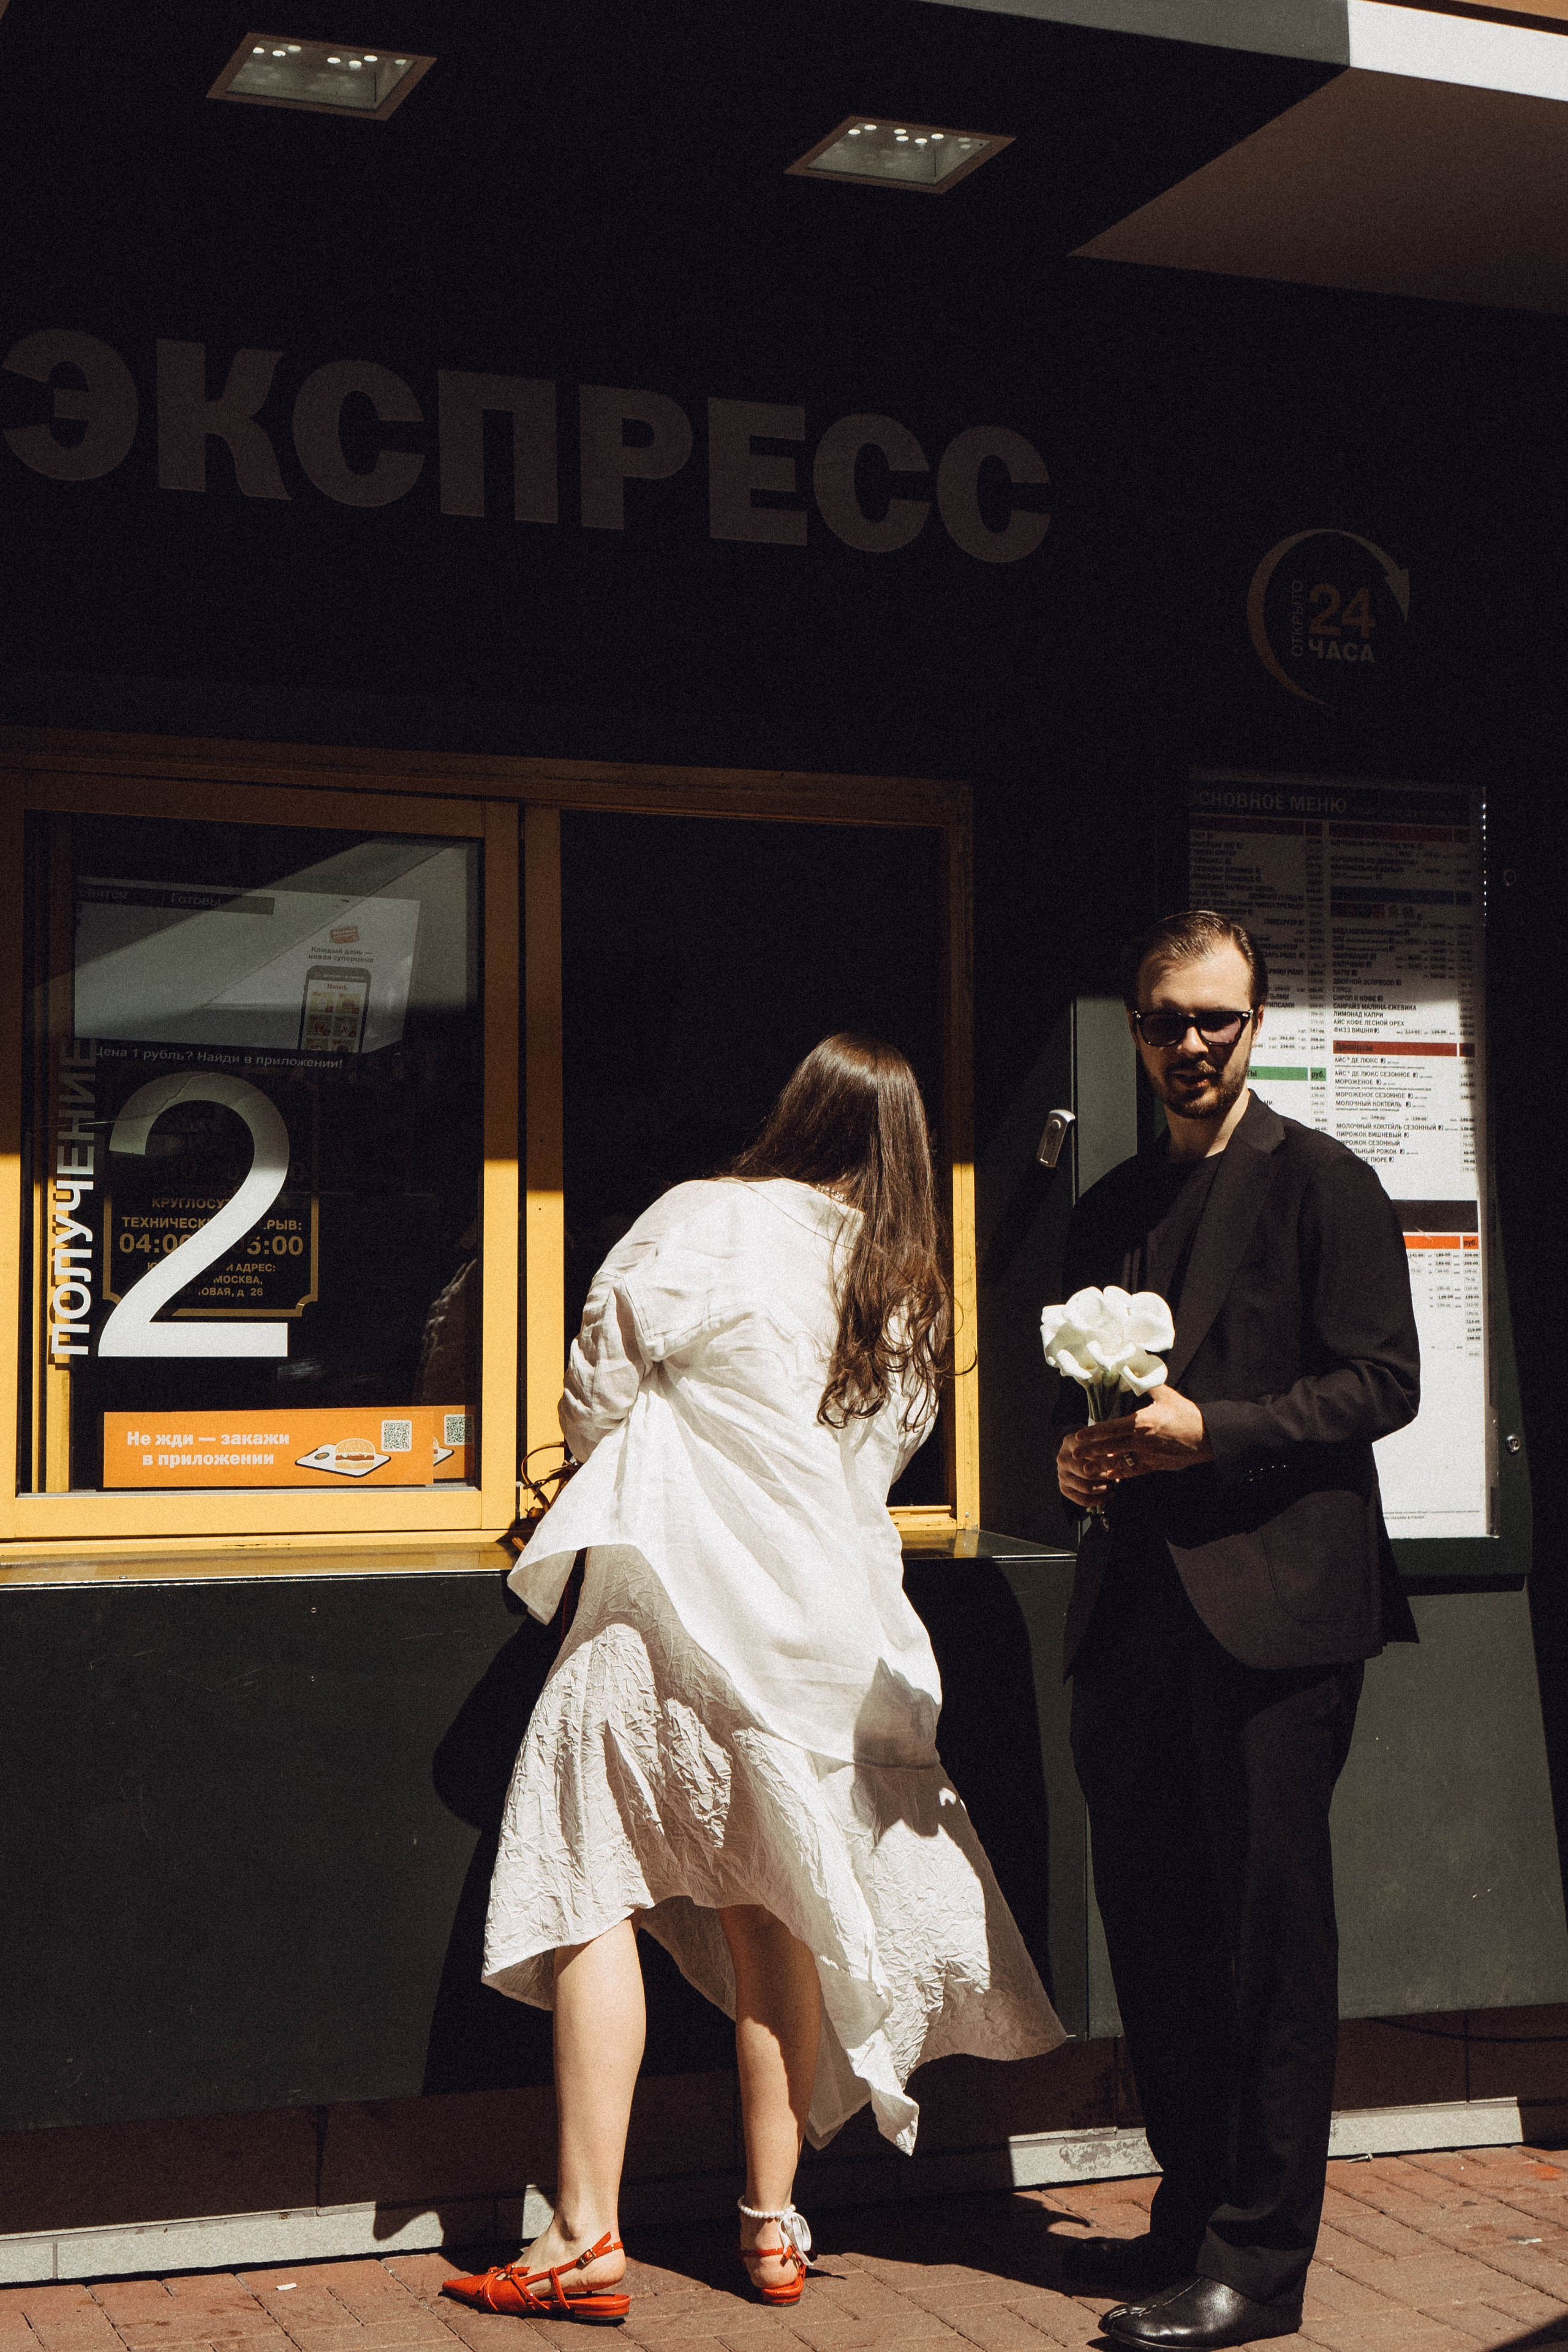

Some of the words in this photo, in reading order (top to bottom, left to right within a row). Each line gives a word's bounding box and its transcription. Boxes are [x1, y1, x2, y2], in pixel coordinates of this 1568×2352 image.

[2, 328, 1052, 563] ЭКСПРЕСС
[1309, 583, 1376, 638] 24
[1308, 639, 1375, 662] ЧАСА
[1289, 795, 1345, 813] МЕНЮ
[131, 1048, 138, 1058] 1
[142, 1049, 192, 1063] рубль?
[197, 1051, 240, 1063] Найди
[256, 1056, 344, 1069] приложении!
[1311, 1071, 1325, 1079] руб.
[51, 1037, 97, 1355] ПОЛУЧЕНИЕ
[98, 1071, 290, 1357] 2
[121, 1217, 211, 1229] ТЕХНИЧЕСК
[263, 1220, 302, 1231] РЫВ:
[1463, 1238, 1478, 1247] руб.
[236, 1262, 276, 1274] АДРЕС:
[201, 1287, 235, 1298] ОВАЯ,
[250, 1287, 263, 1297] 26
[127, 1431, 151, 1445] Не
[155, 1433, 194, 1449] жди
[221, 1431, 290, 1444] закажи
[142, 1453, 154, 1465] в
[158, 1453, 274, 1469] приложении
